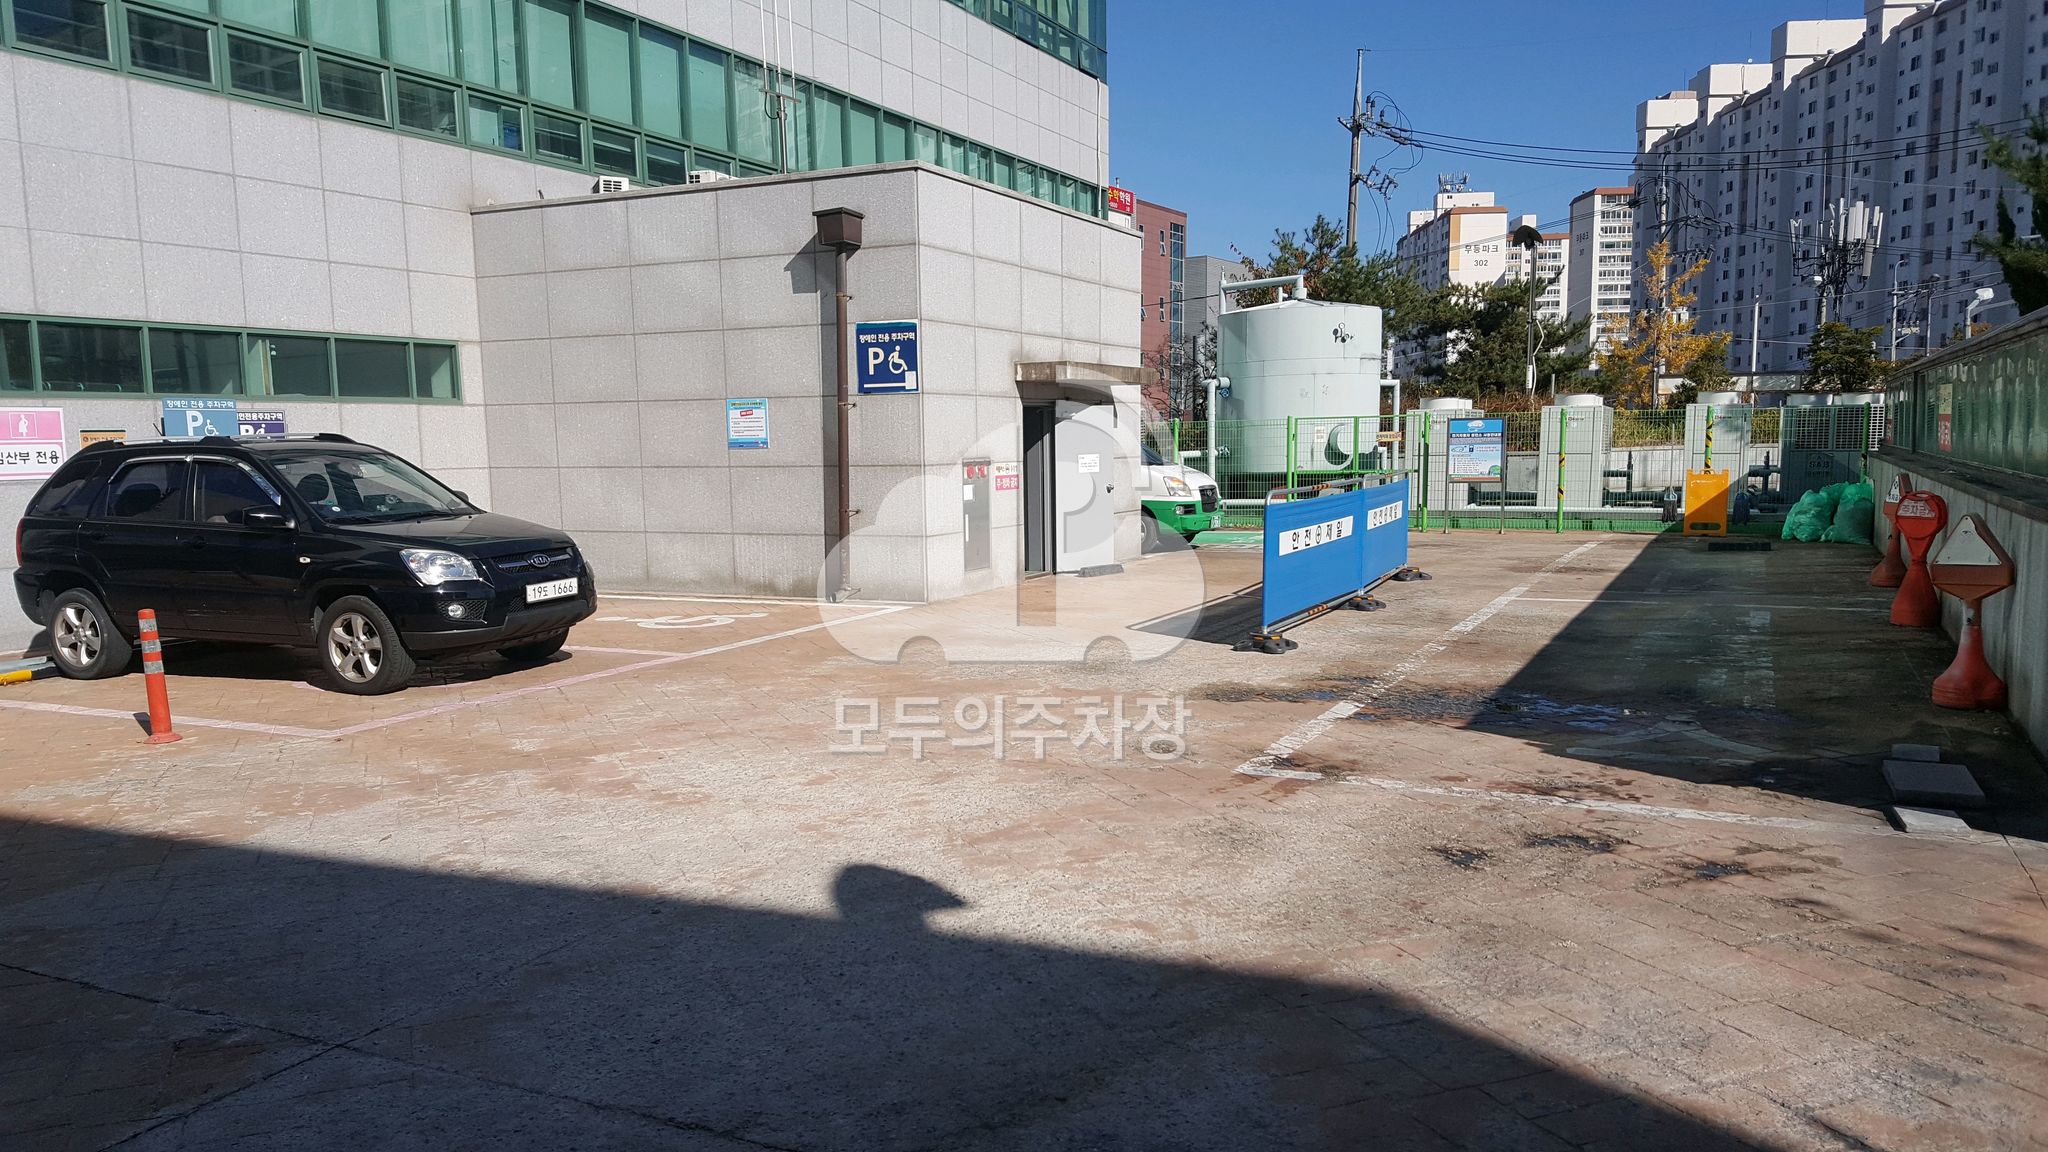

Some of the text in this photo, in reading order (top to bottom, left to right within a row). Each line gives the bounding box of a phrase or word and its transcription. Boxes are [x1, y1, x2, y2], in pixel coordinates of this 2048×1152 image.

[1464, 244, 1499, 254] 무등파크
[1473, 259, 1489, 267] 302
[859, 332, 915, 343] 장애인 전용 주차구역
[868, 347, 885, 375] P
[166, 400, 235, 409] 장애인 전용 주차구역
[185, 411, 204, 437] P
[36, 450, 60, 465] 전용
[552, 581, 574, 595] 1666
